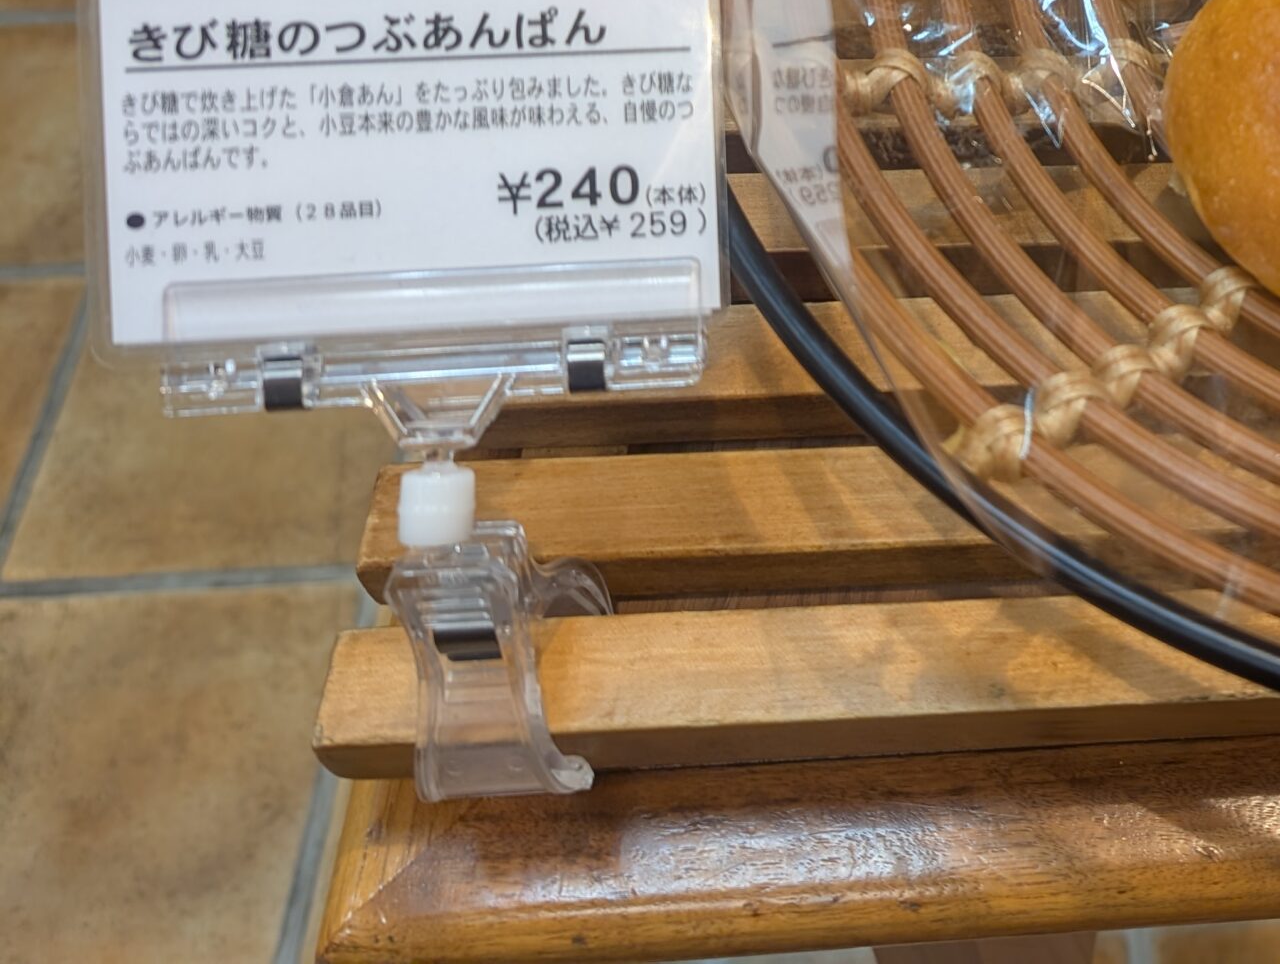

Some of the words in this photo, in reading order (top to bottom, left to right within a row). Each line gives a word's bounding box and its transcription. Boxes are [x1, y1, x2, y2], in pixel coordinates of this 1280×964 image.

[127, 7, 607, 65] きび糖のつぶあんぱん
[123, 145, 269, 174] ぶあんぱんです。
[496, 164, 641, 215] ¥240
